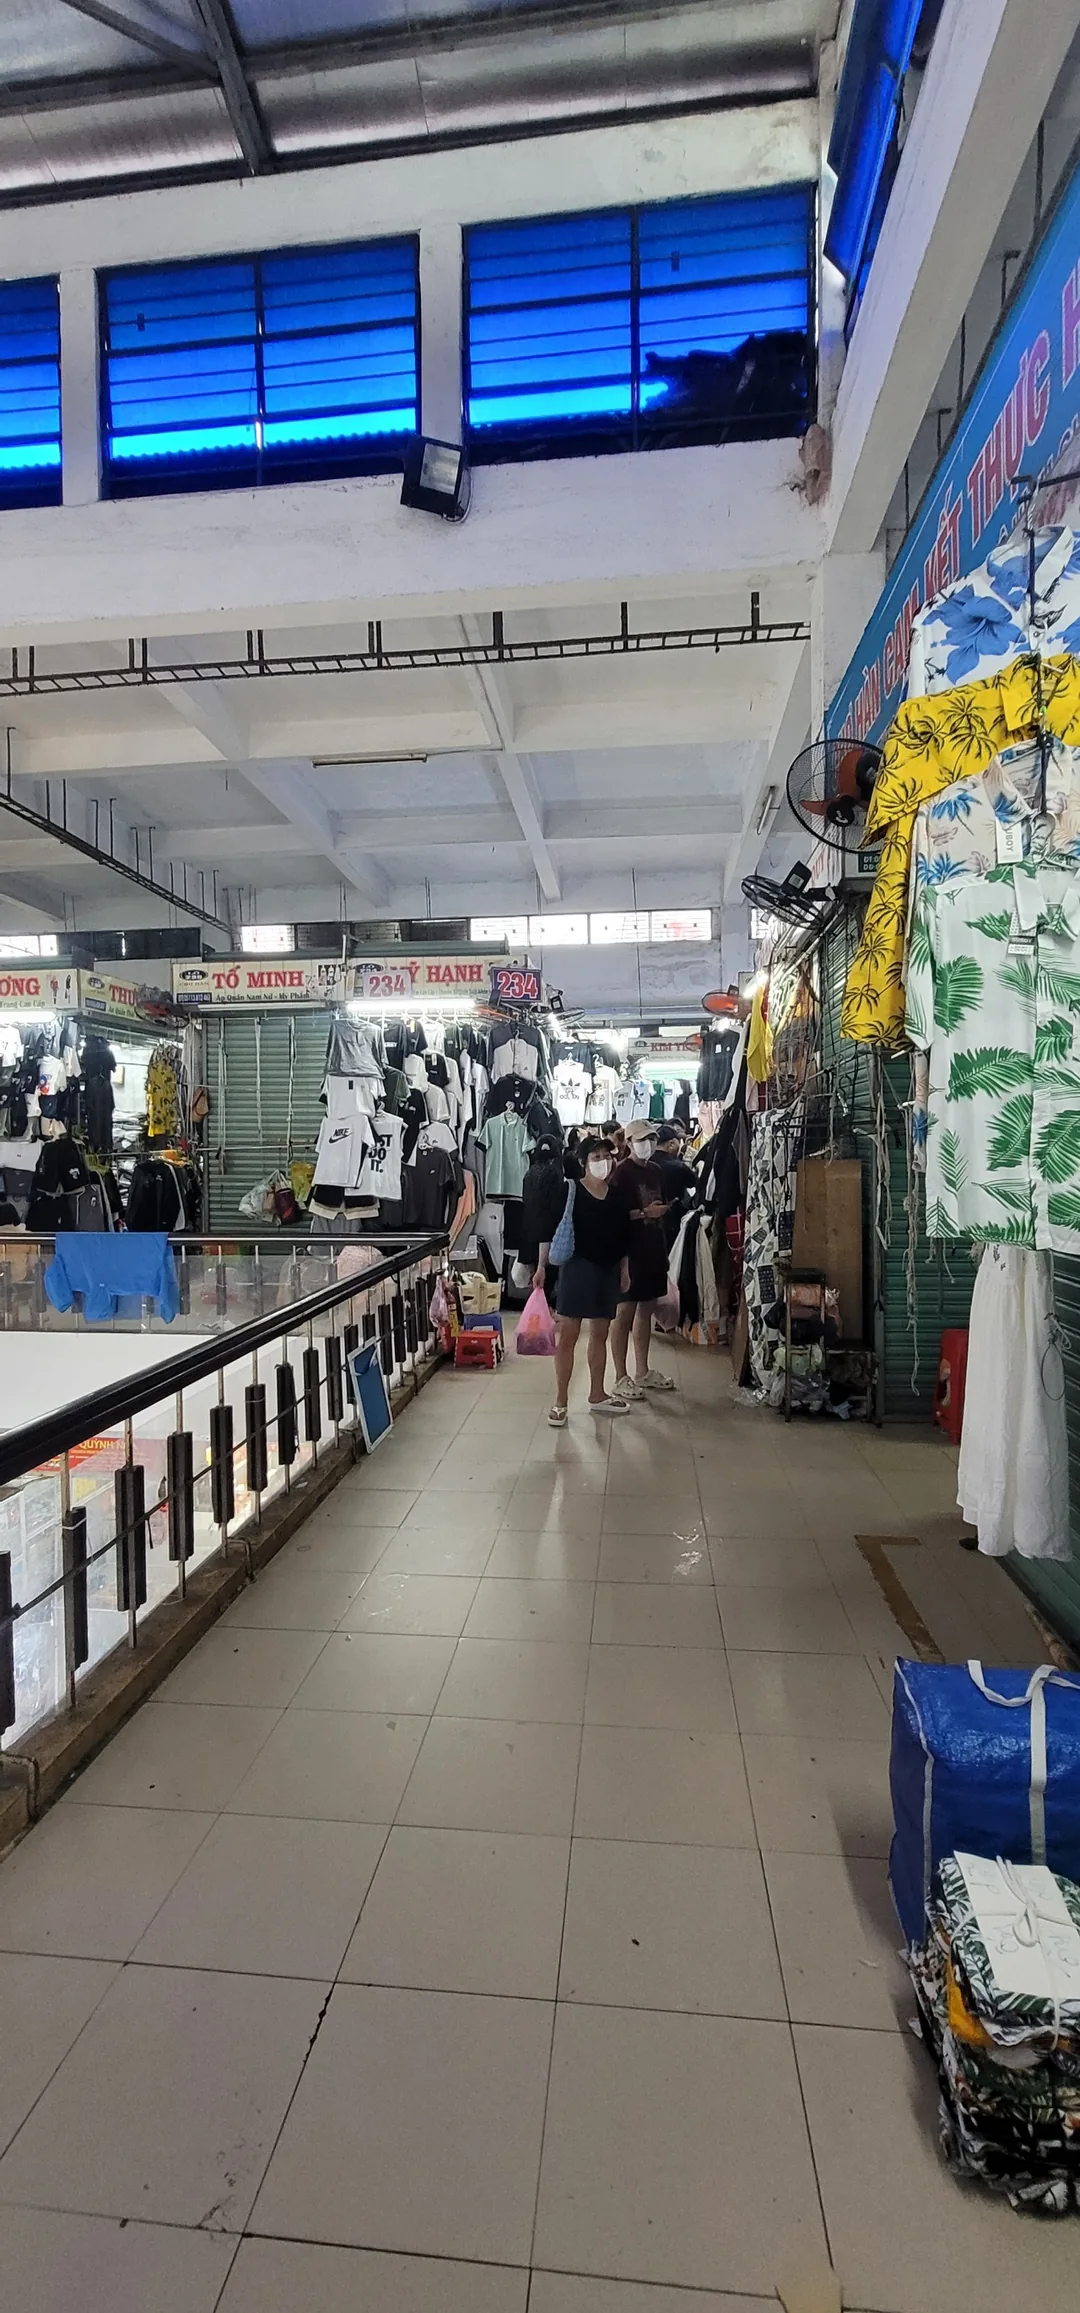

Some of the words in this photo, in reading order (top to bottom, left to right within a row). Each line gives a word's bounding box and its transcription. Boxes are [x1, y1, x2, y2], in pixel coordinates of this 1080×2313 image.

[923, 480, 963, 602] KẾT
[966, 328, 1050, 550] THỰC
[212, 965, 241, 989] TỐ
[247, 971, 304, 988] MINH
[369, 975, 406, 997] 234
[426, 965, 483, 987] HẠNH
[497, 971, 537, 999] 234
[333, 1127, 350, 1137] NIKE
[368, 1146, 386, 1161] DO
[370, 1160, 384, 1173] IT.
[80, 1438, 114, 1449] QUỲNH
